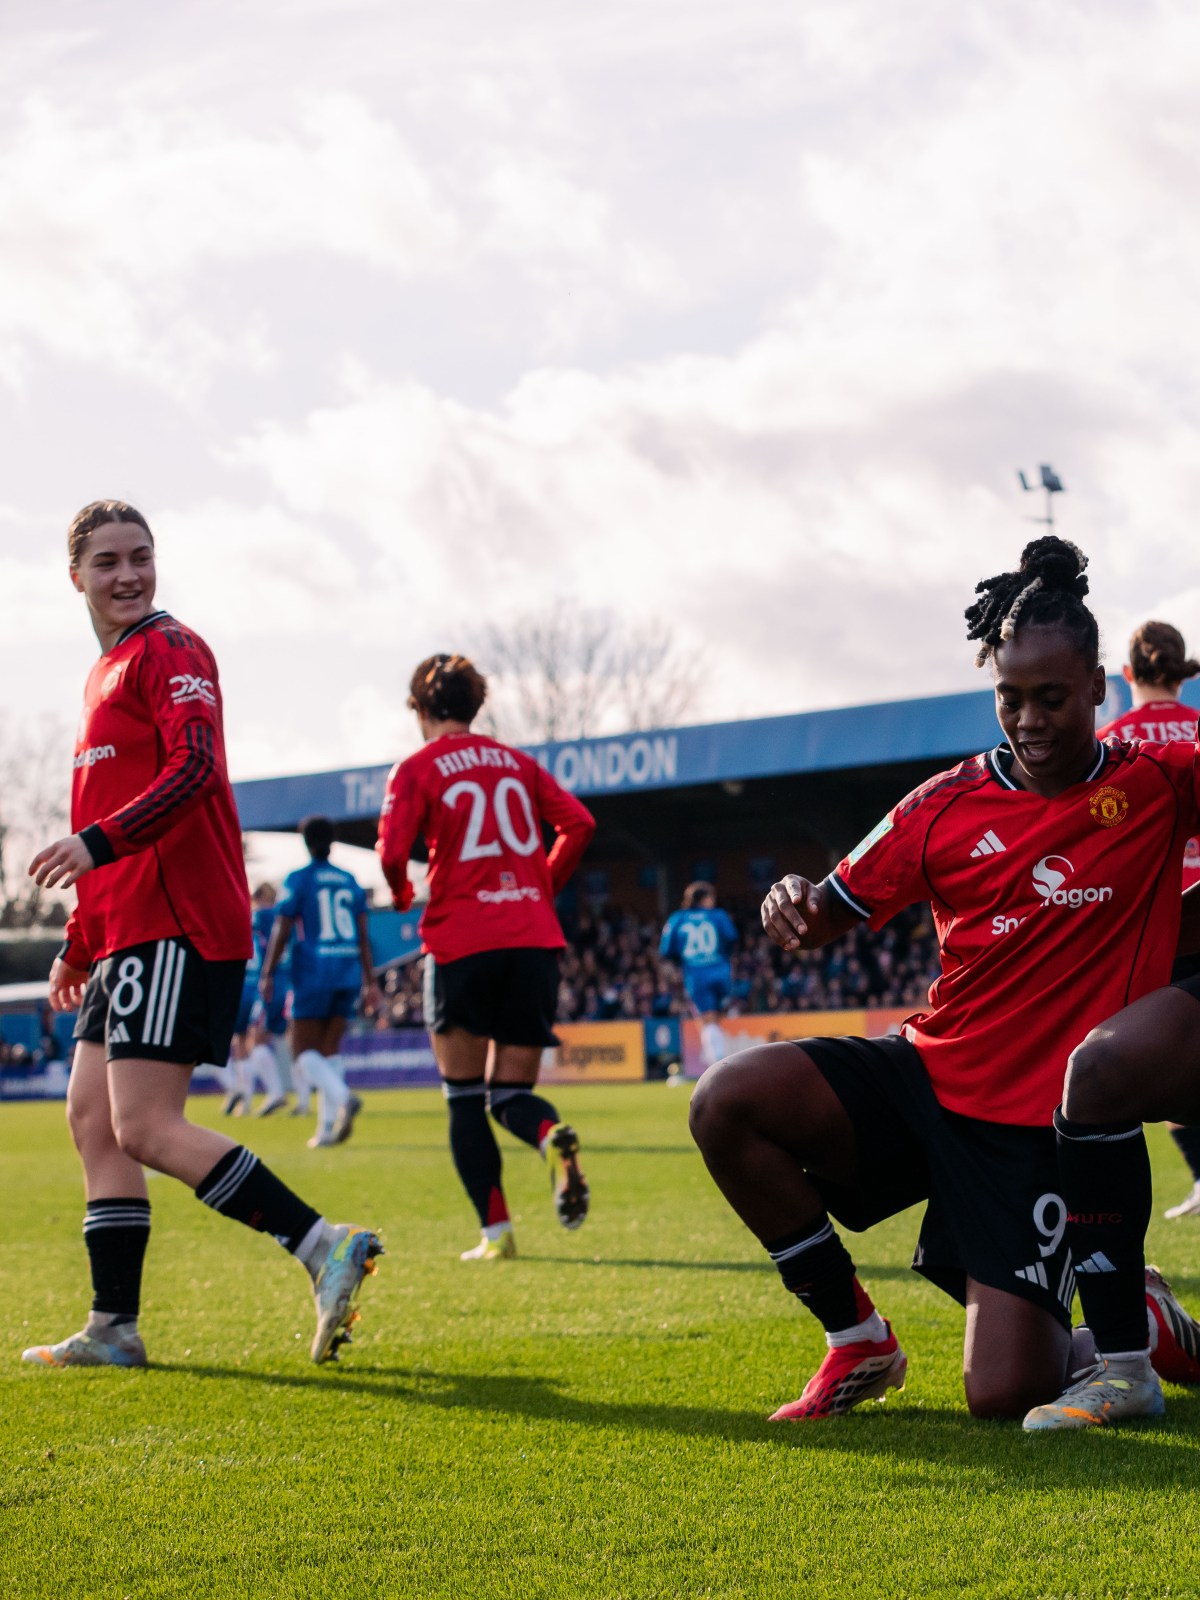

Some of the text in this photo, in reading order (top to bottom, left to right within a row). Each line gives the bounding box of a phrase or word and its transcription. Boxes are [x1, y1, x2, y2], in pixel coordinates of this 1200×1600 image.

[1140, 720, 1199, 743] TISS
[442, 777, 540, 862] 20
[317, 887, 355, 941] 16
[111, 955, 144, 1017] 8
[1032, 1192, 1068, 1258] 9
